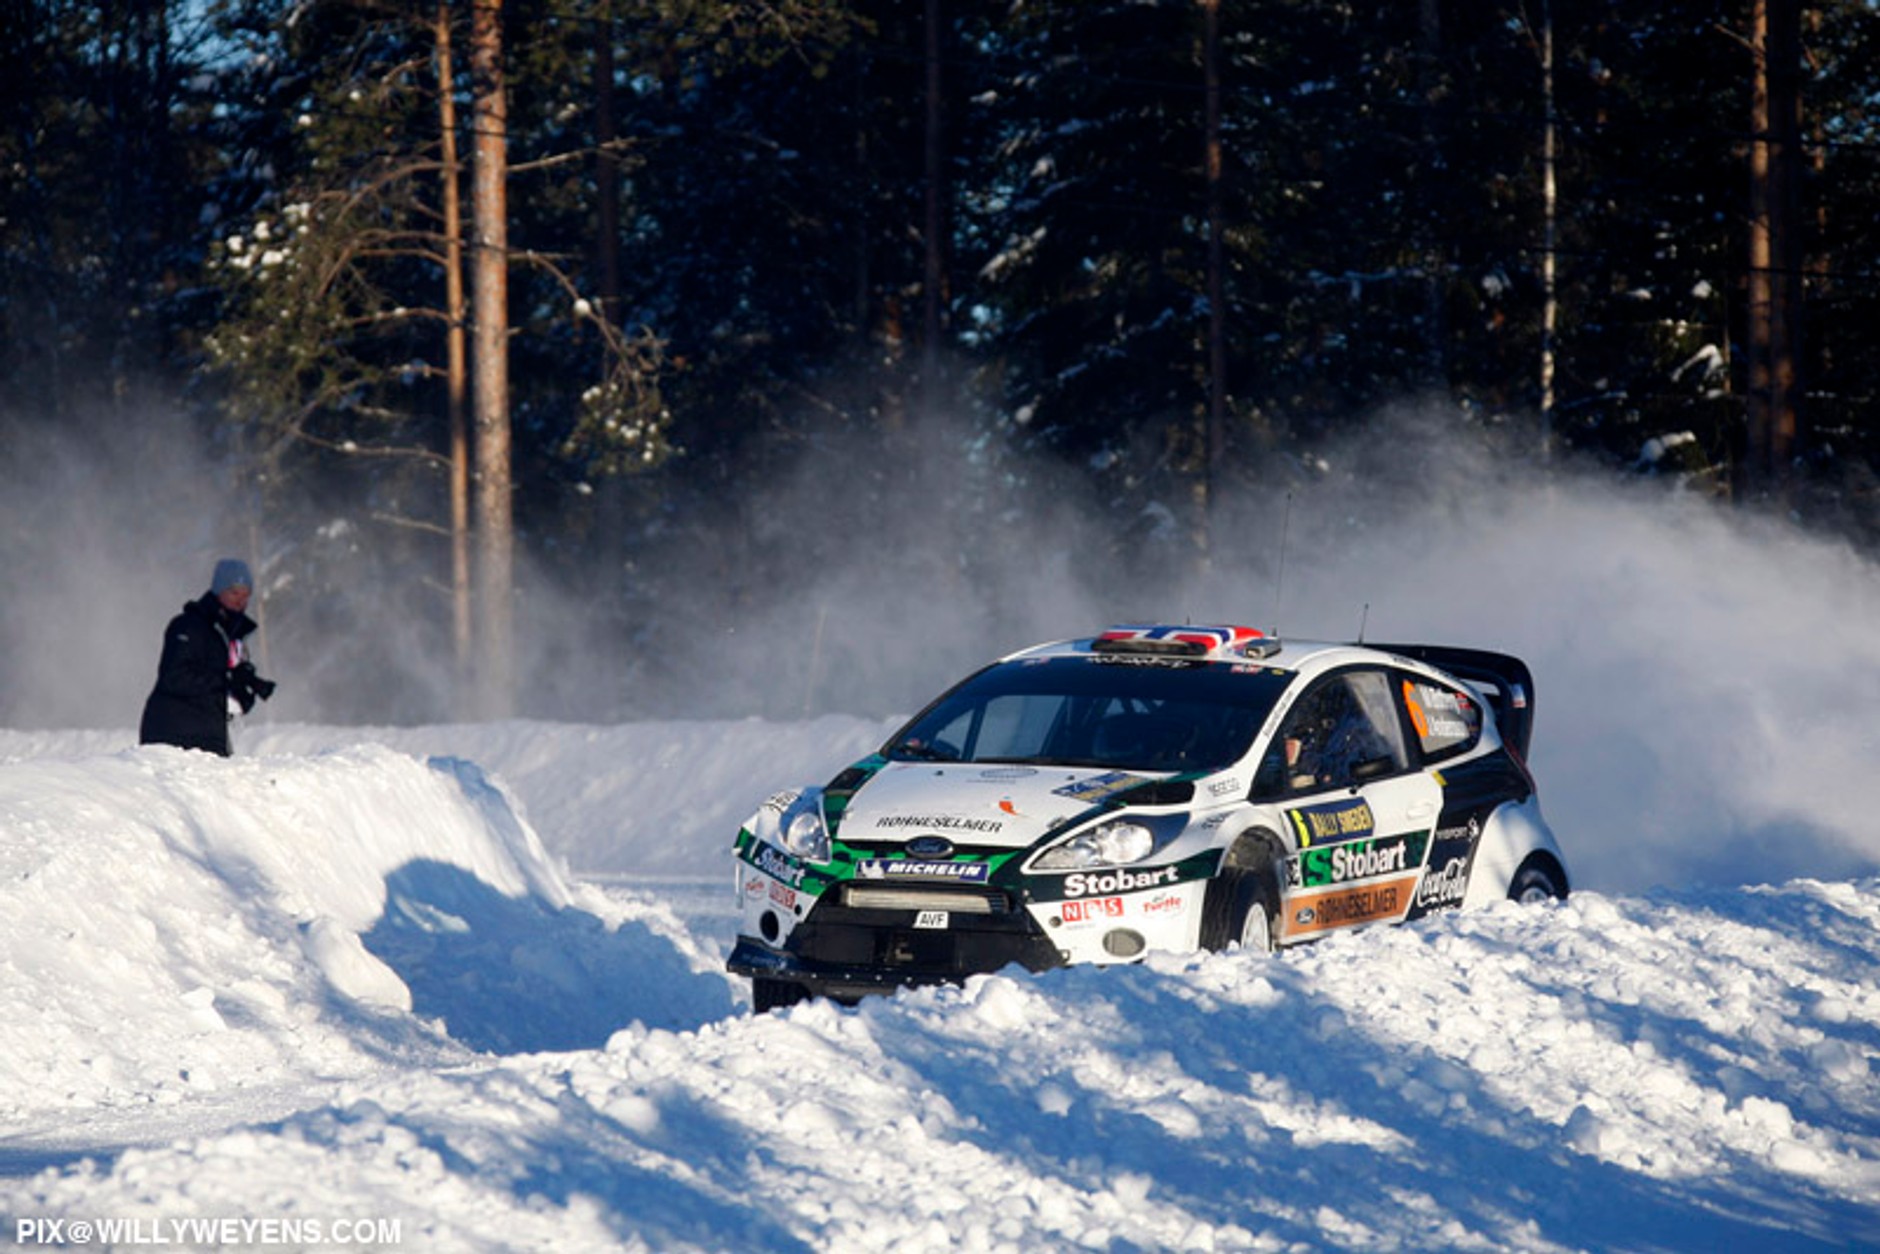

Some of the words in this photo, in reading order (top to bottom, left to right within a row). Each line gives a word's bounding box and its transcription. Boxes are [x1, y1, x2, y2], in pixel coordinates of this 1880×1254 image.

[1337, 803, 1373, 833] SWEDEN
[887, 862, 982, 877] MICHELIN
[1331, 841, 1406, 881] Stobart
[1063, 864, 1179, 897] Stobart
[919, 912, 946, 926] AVF
